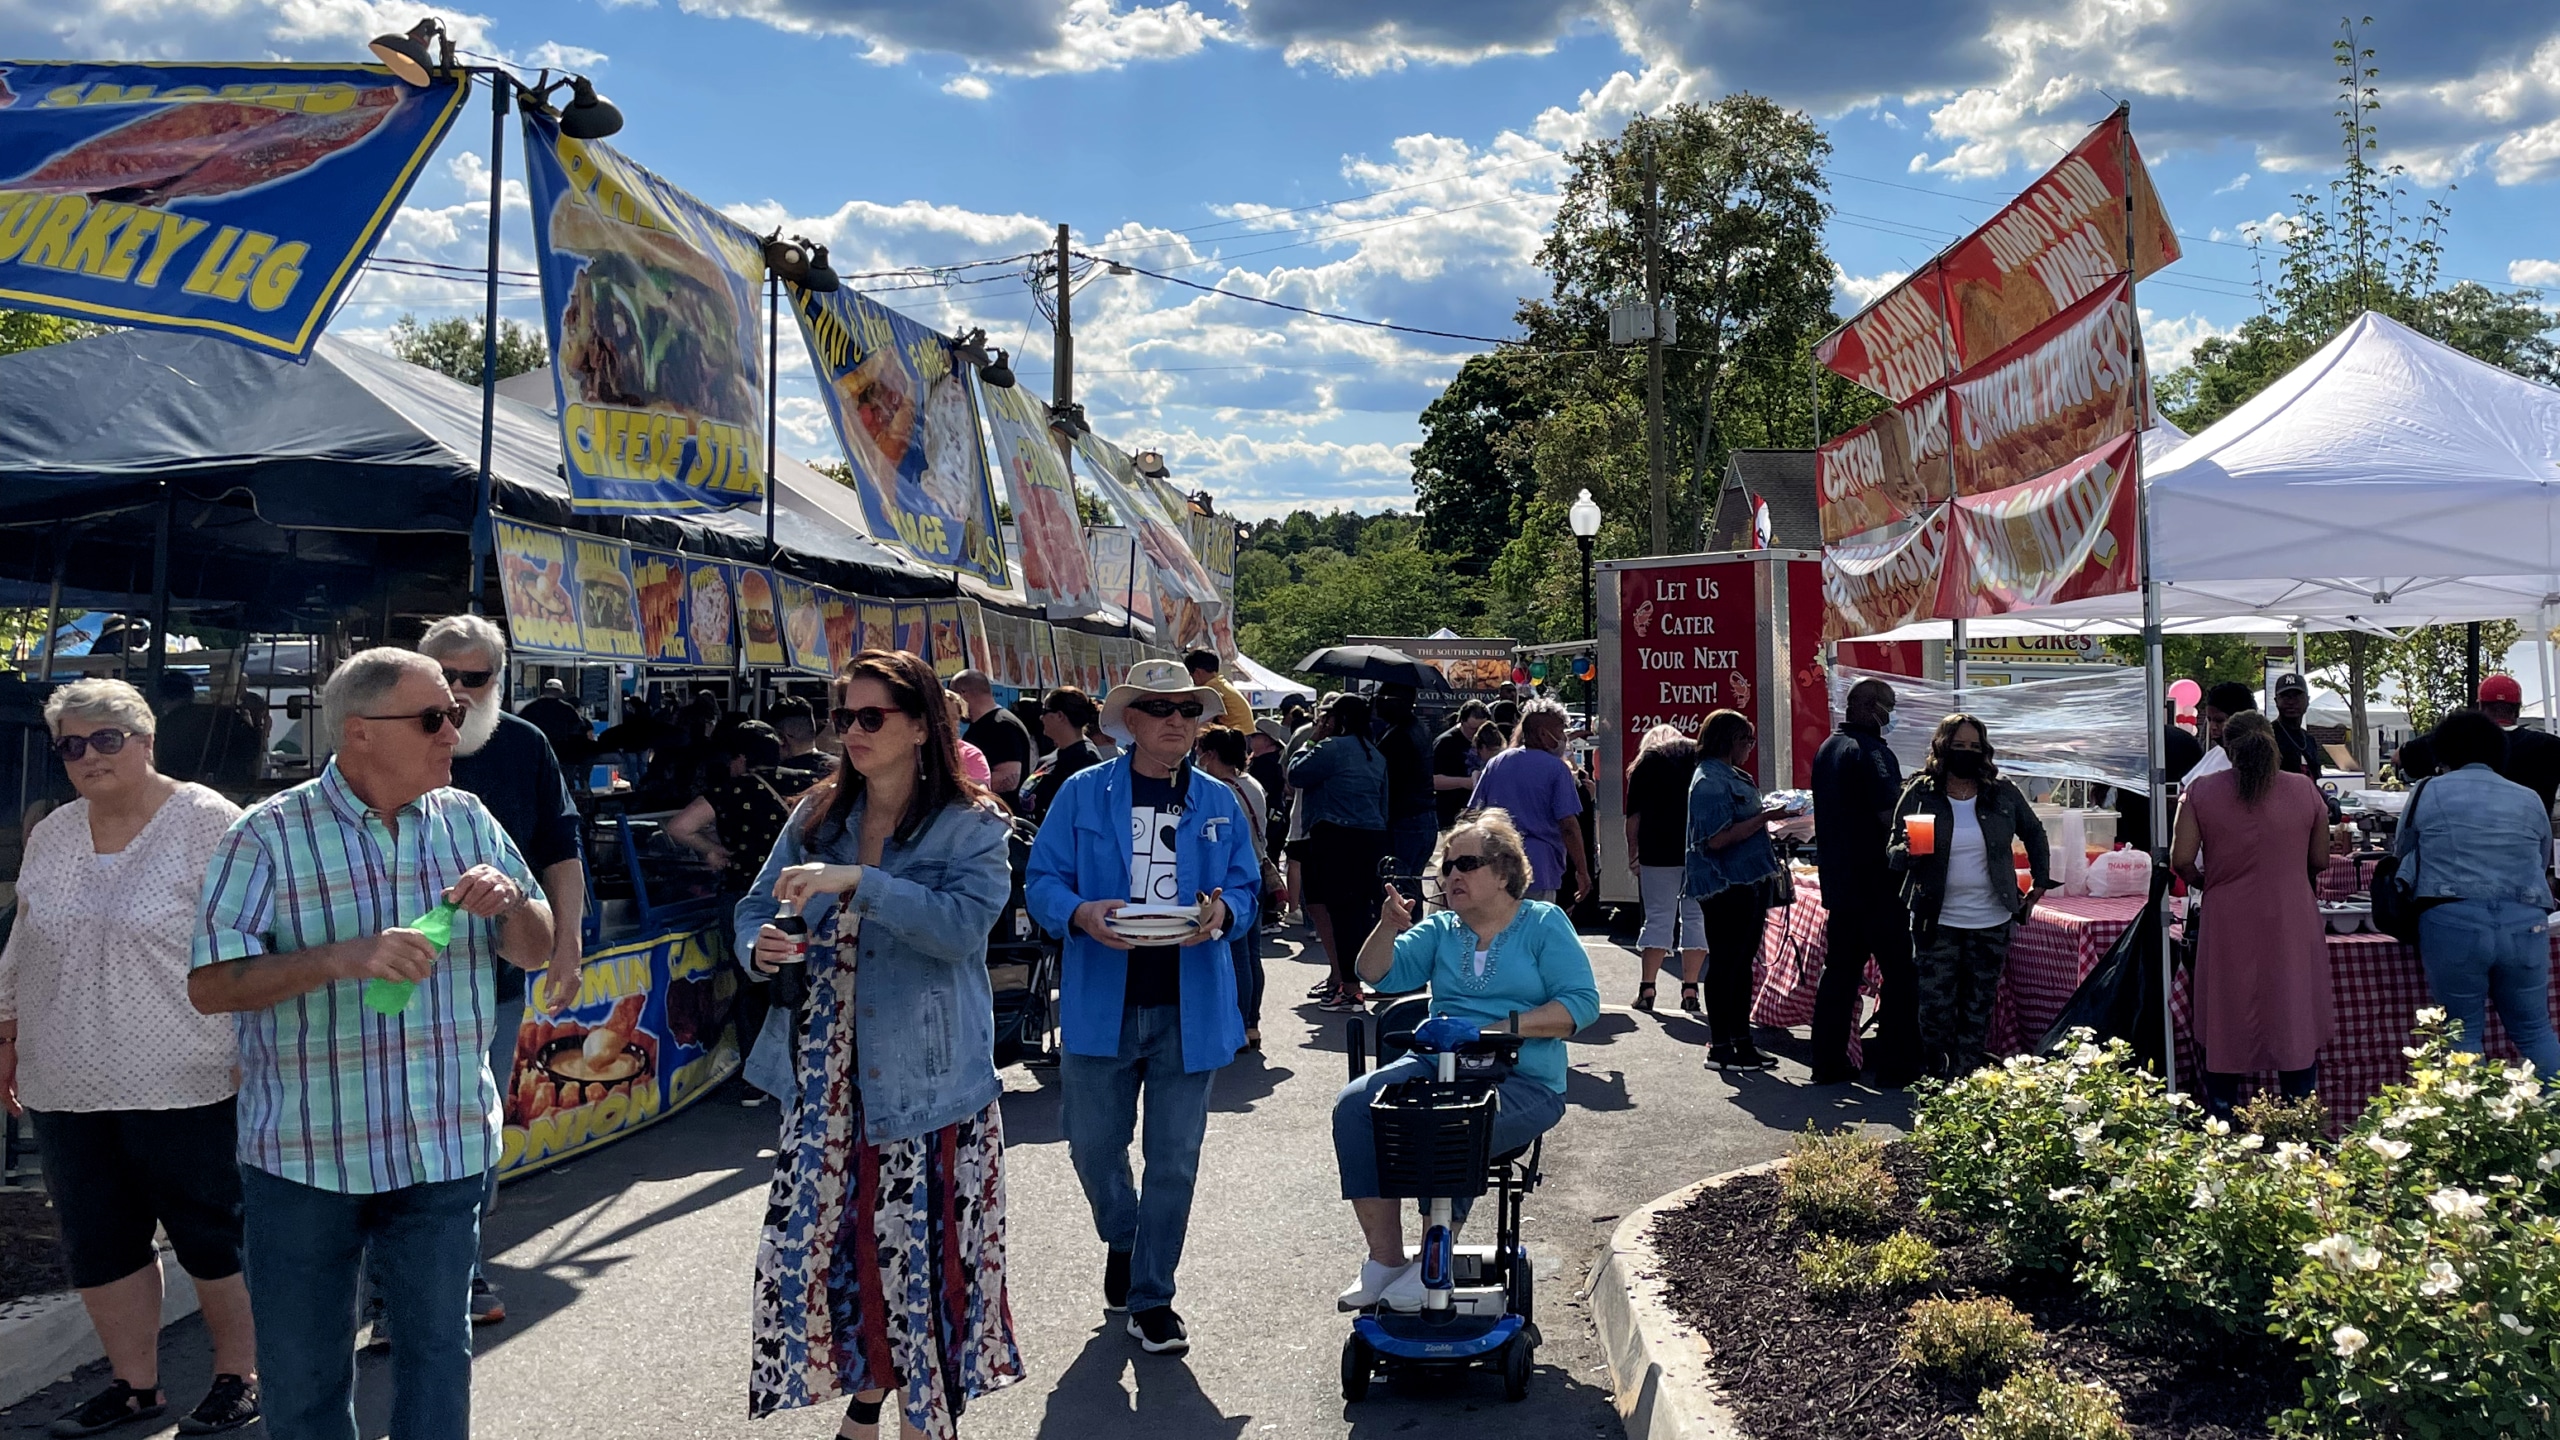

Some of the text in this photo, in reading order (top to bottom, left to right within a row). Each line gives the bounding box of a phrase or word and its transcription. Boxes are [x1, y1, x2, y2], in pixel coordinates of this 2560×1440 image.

[1980, 155, 2112, 274] JUMBO CAJUN
[182, 226, 312, 312] LEG
[2031, 222, 2119, 312] WINGS
[1853, 283, 1941, 366] ATLANTA
[1961, 353, 2036, 451] CHICKEN
[687, 419, 764, 495] STEA
[1822, 427, 1887, 504] CATFISH
[1417, 648, 1506, 657] THE SOUTHERN FRIED
[2017, 634, 2092, 650] Cakes
[1417, 691, 1456, 700] CATFSH
[499, 1082, 662, 1170] ONION
